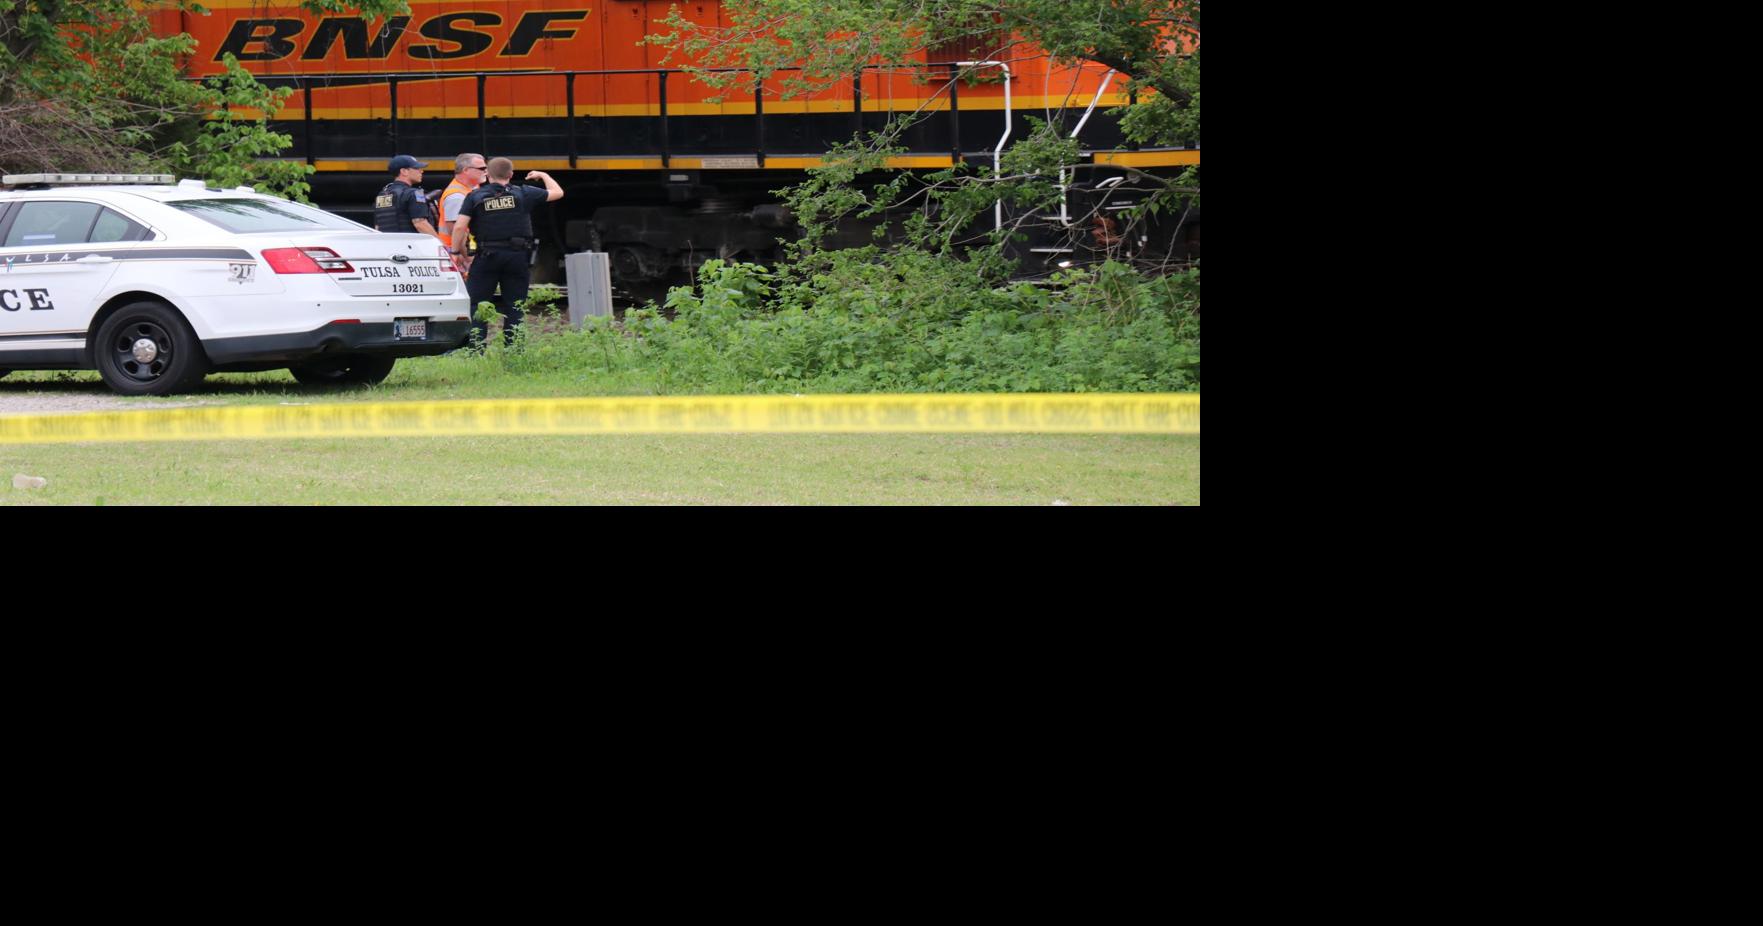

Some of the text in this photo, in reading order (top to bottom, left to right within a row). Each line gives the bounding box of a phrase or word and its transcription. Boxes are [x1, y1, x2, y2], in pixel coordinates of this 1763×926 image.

[211, 8, 590, 63] BNSF
[486, 196, 513, 209] POLICE
[360, 266, 440, 278] TULSA POLICE
[392, 283, 424, 293] 13021
